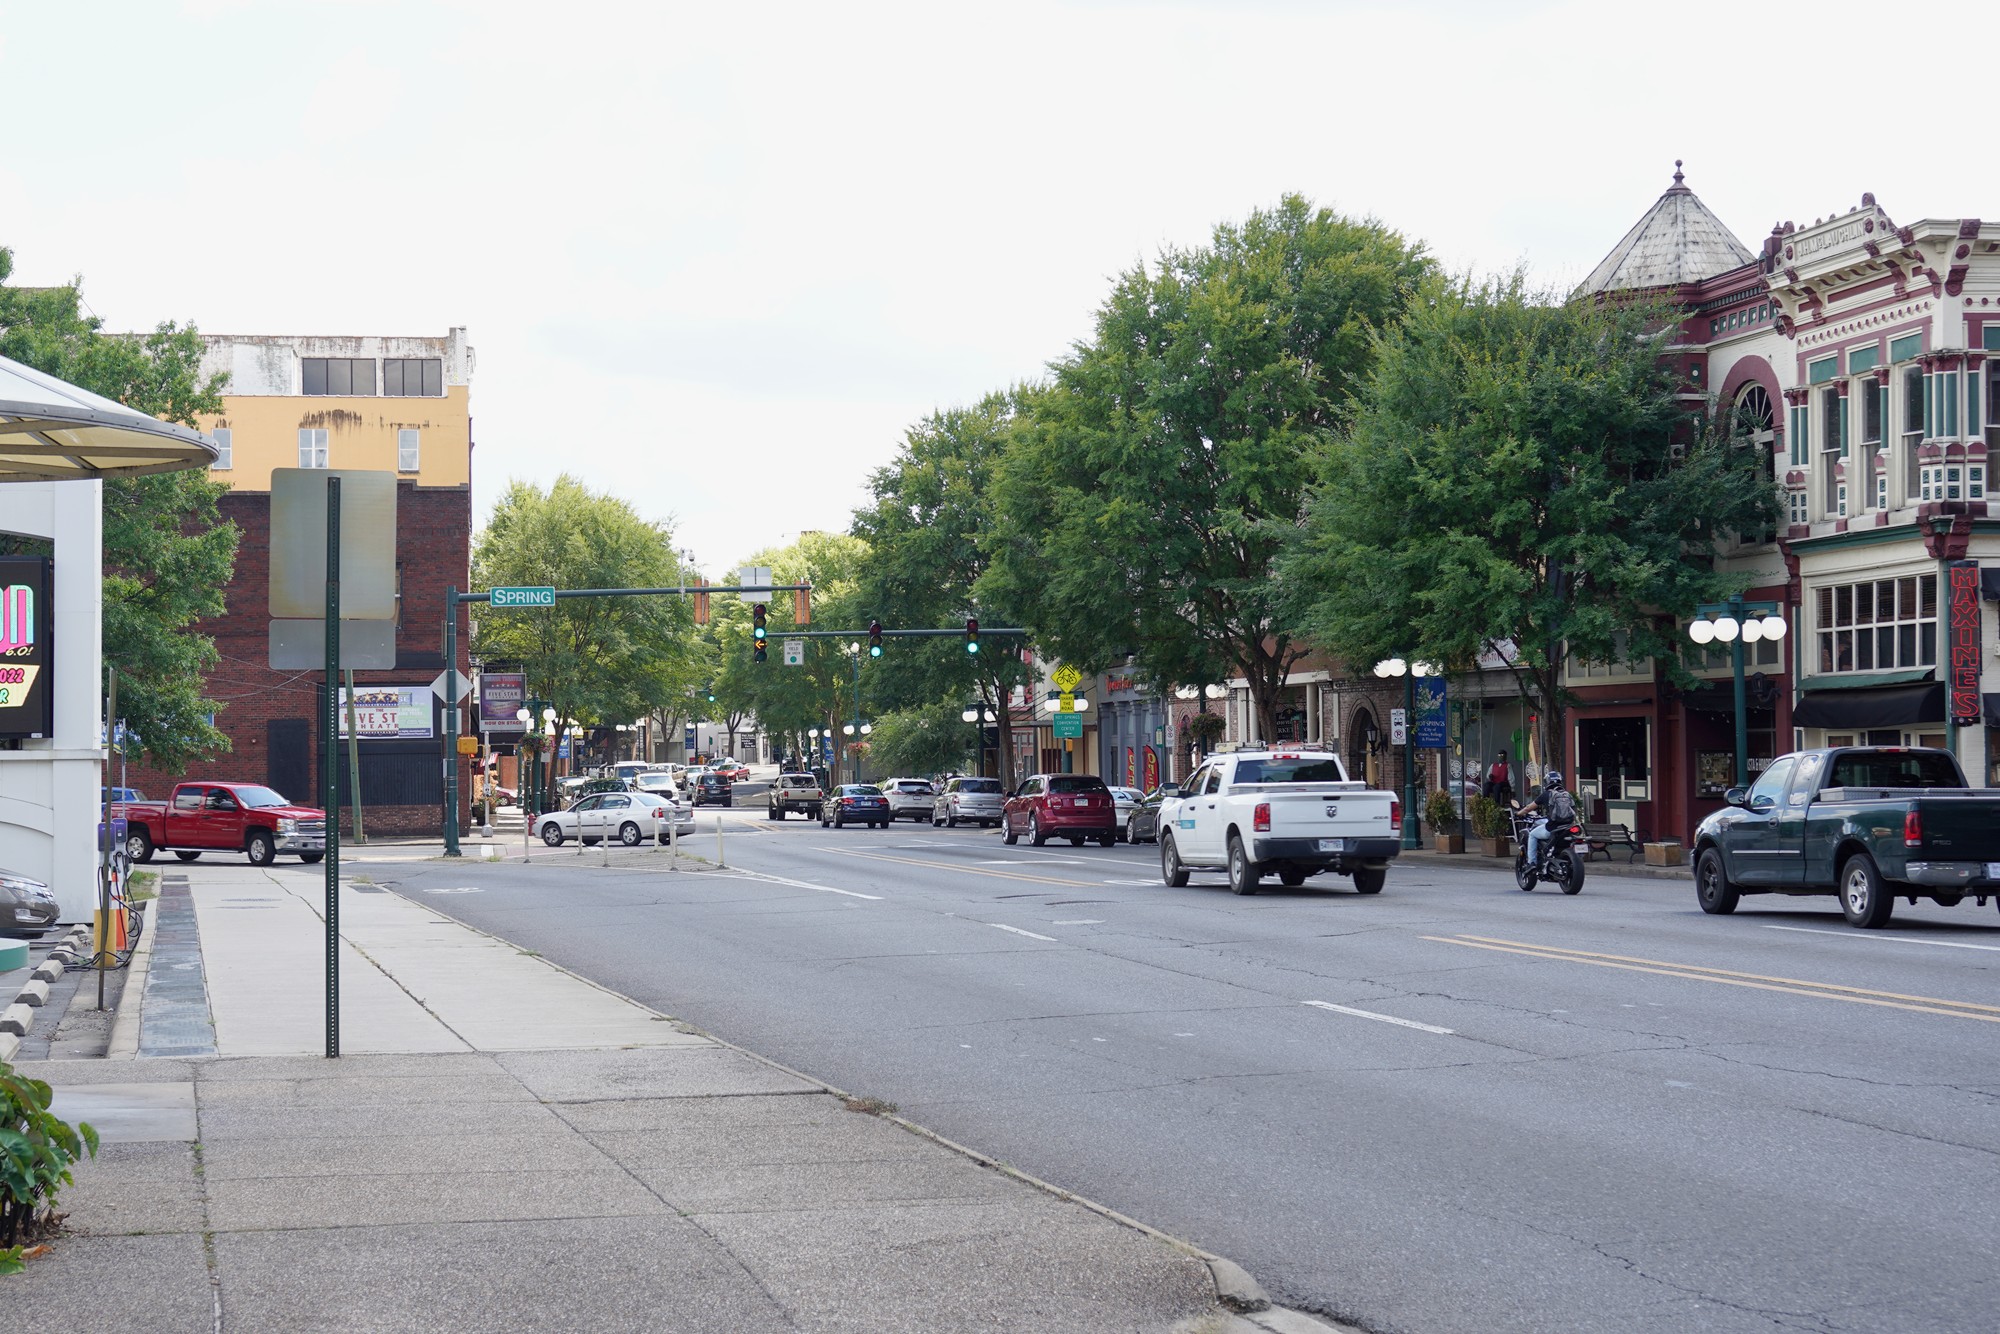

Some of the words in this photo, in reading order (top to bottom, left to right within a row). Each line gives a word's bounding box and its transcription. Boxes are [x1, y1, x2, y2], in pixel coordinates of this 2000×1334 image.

[494, 589, 552, 604] SPRING
[1951, 567, 1979, 717] MAXINE'S
[5, 646, 34, 656] 6.0!
[344, 713, 374, 724] FVE
